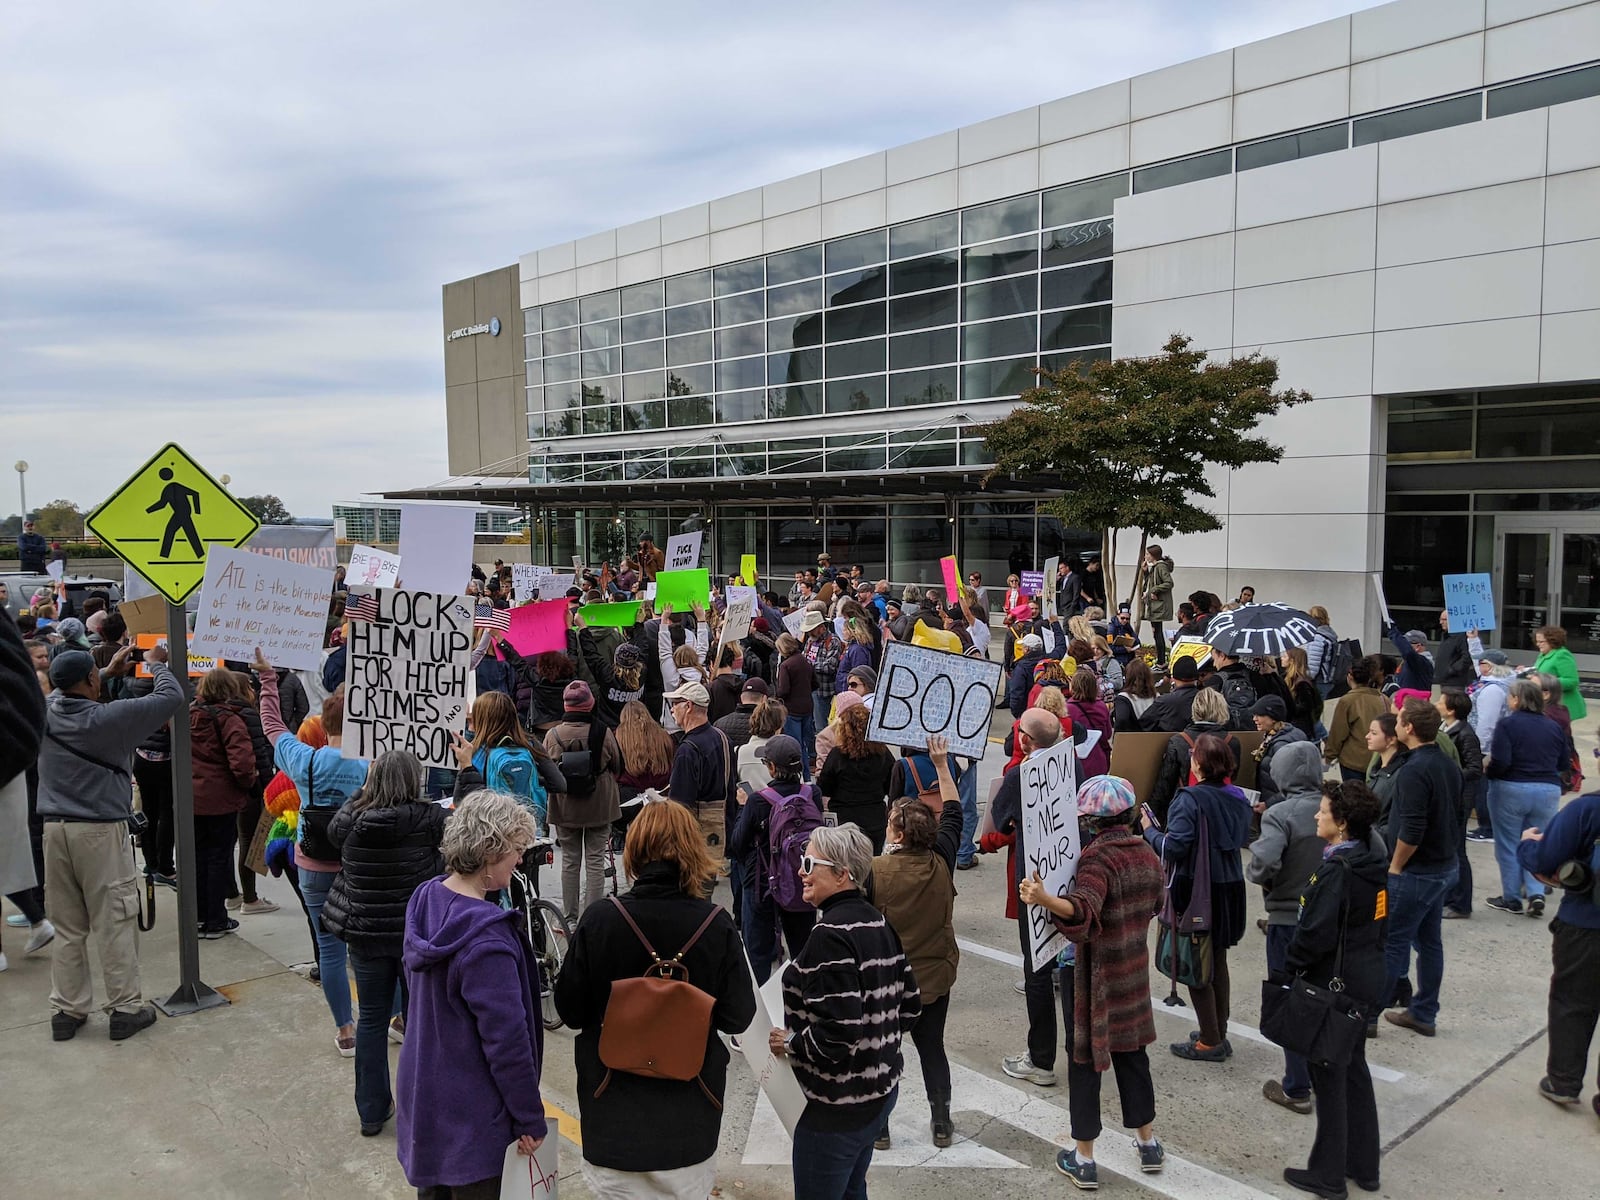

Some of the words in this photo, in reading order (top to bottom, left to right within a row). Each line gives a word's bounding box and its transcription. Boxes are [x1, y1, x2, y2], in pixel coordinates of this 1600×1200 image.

[468, 323, 489, 336] Building
[351, 553, 368, 565] BYE
[676, 544, 692, 555] FUCK
[381, 560, 398, 574] BYE
[513, 565, 539, 578] WHERE
[672, 556, 692, 568] TRUMP
[215, 560, 247, 589] ATL
[254, 573, 265, 593] is
[267, 577, 288, 597] the
[1447, 581, 1486, 595] IMPEACH
[212, 592, 228, 609] of
[236, 597, 251, 611] the
[375, 588, 458, 630] LOCK
[1447, 604, 1477, 617] #BLUE
[209, 613, 221, 628] We
[225, 617, 240, 630] will
[244, 620, 263, 632] NOT
[263, 621, 284, 636] allow
[1463, 617, 1486, 629] WAVE
[202, 632, 219, 642] and
[258, 638, 265, 648] to
[268, 637, 278, 648] be
[352, 622, 416, 661] HIM
[430, 631, 470, 664] UP
[352, 655, 393, 689] FOR
[406, 660, 466, 698] HIGH
[348, 685, 440, 724] CRIMES
[444, 704, 462, 724] AND
[878, 664, 994, 740] BOO
[348, 718, 464, 768] TREASON
[1026, 748, 1073, 809] SHOW
[1037, 796, 1065, 844] ME
[1029, 836, 1074, 881] YOUR
